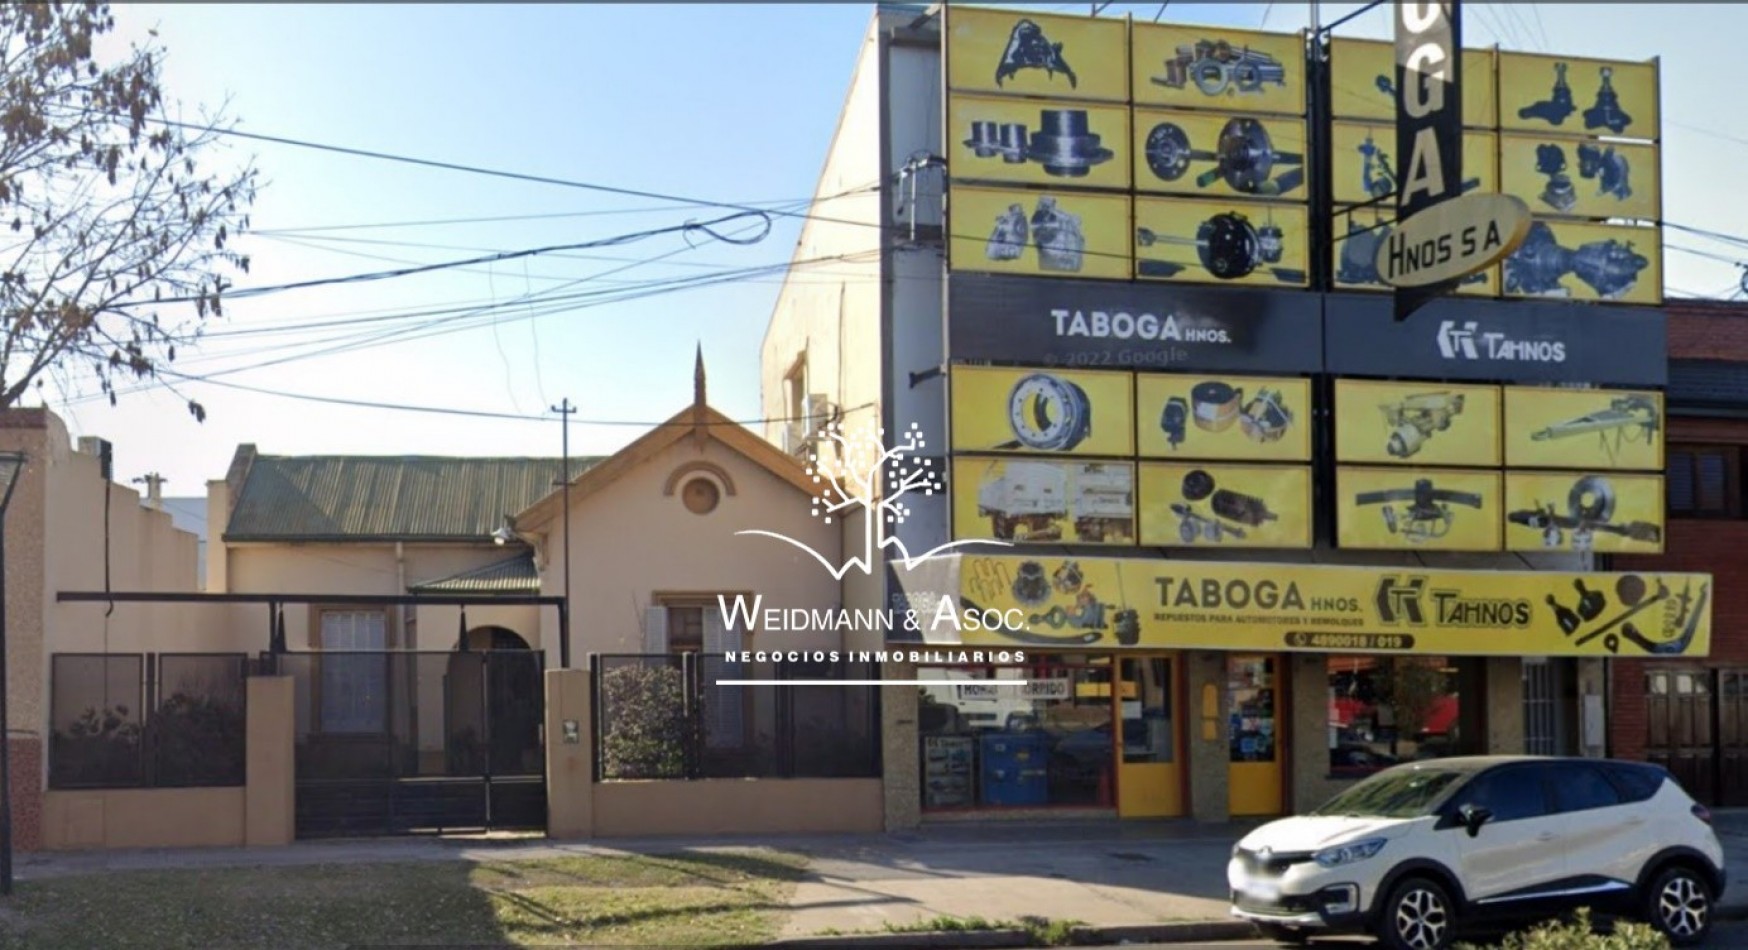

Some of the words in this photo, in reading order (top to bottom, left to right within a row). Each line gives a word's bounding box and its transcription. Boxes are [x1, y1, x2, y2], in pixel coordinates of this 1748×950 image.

[1388, 232, 1452, 279] HNOS
[1051, 309, 1181, 341] TABOGA
[1185, 328, 1232, 343] HNOS.
[1484, 332, 1566, 362] TAHNOS
[1155, 577, 1305, 610] TABOGA
[1311, 597, 1363, 612] HNOS.
[1431, 591, 1531, 626] TAHNOS
[1154, 613, 1206, 623] REPUESTOS
[1209, 614, 1233, 623] PARA
